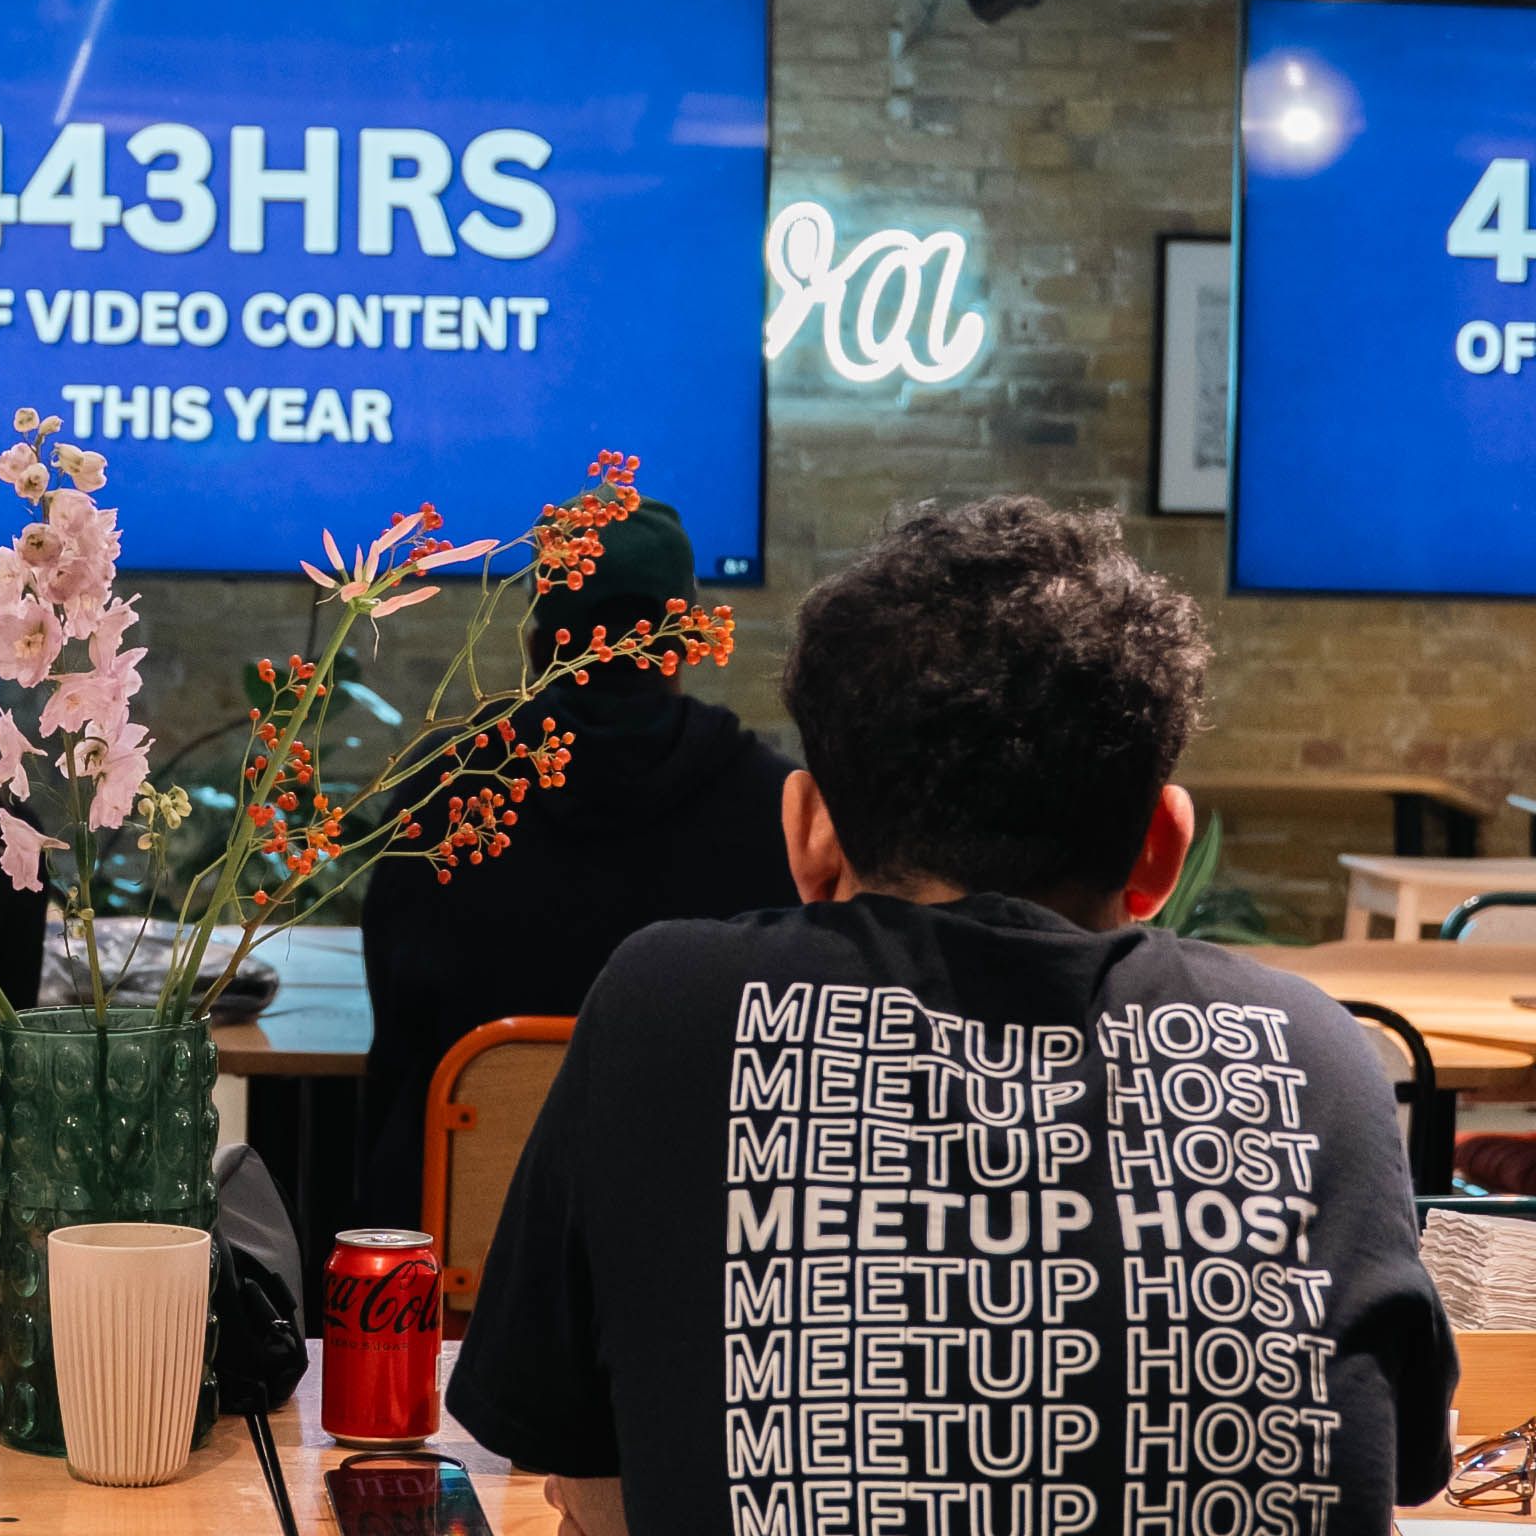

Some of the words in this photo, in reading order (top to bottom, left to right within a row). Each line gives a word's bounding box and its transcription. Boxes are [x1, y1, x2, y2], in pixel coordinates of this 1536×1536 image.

[25, 290, 227, 346] VIDEO
[242, 293, 550, 351] CONTENT
[1456, 320, 1536, 374] OF
[61, 385, 212, 440] THIS
[224, 388, 393, 444] YEAR
[736, 982, 1085, 1081] MEETUP
[1096, 1002, 1289, 1063] HOST
[730, 1047, 1086, 1127] MEETUP
[1106, 1062, 1306, 1128] HOST
[727, 1117, 1091, 1187] MEETUP
[1107, 1125, 1319, 1192] HOST
[727, 1186, 1093, 1254] MEETUP
[1117, 1190, 1319, 1263] HOST
[725, 1257, 1100, 1329] MEETUP
[1124, 1256, 1332, 1329] HOST
[725, 1328, 1100, 1402] MEETUP
[1126, 1326, 1335, 1403] HOST
[726, 1403, 1100, 1478] MEETUP
[1125, 1402, 1340, 1476] HOST
